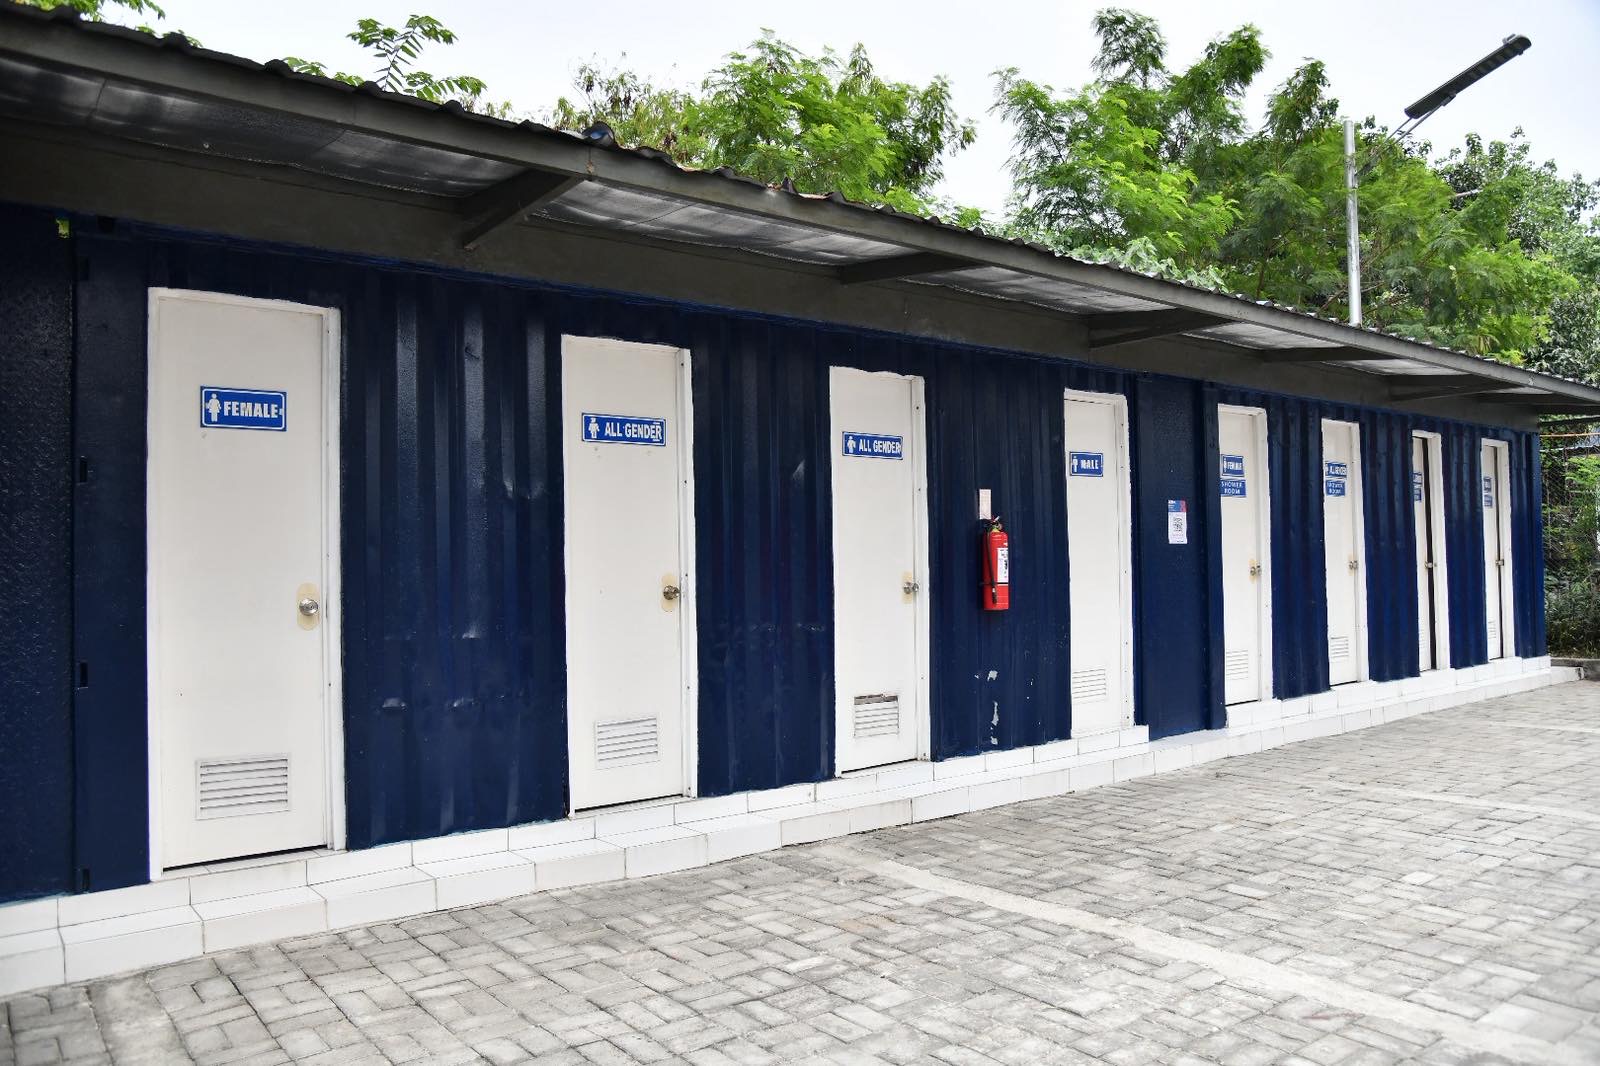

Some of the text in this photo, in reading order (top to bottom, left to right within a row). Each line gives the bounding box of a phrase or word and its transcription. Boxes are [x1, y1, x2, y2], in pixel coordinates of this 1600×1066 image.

[223, 401, 278, 418] FEMALE
[604, 422, 662, 440] ALL GENDER
[858, 439, 901, 454] ALL GENDER
[1080, 459, 1099, 470] MALE
